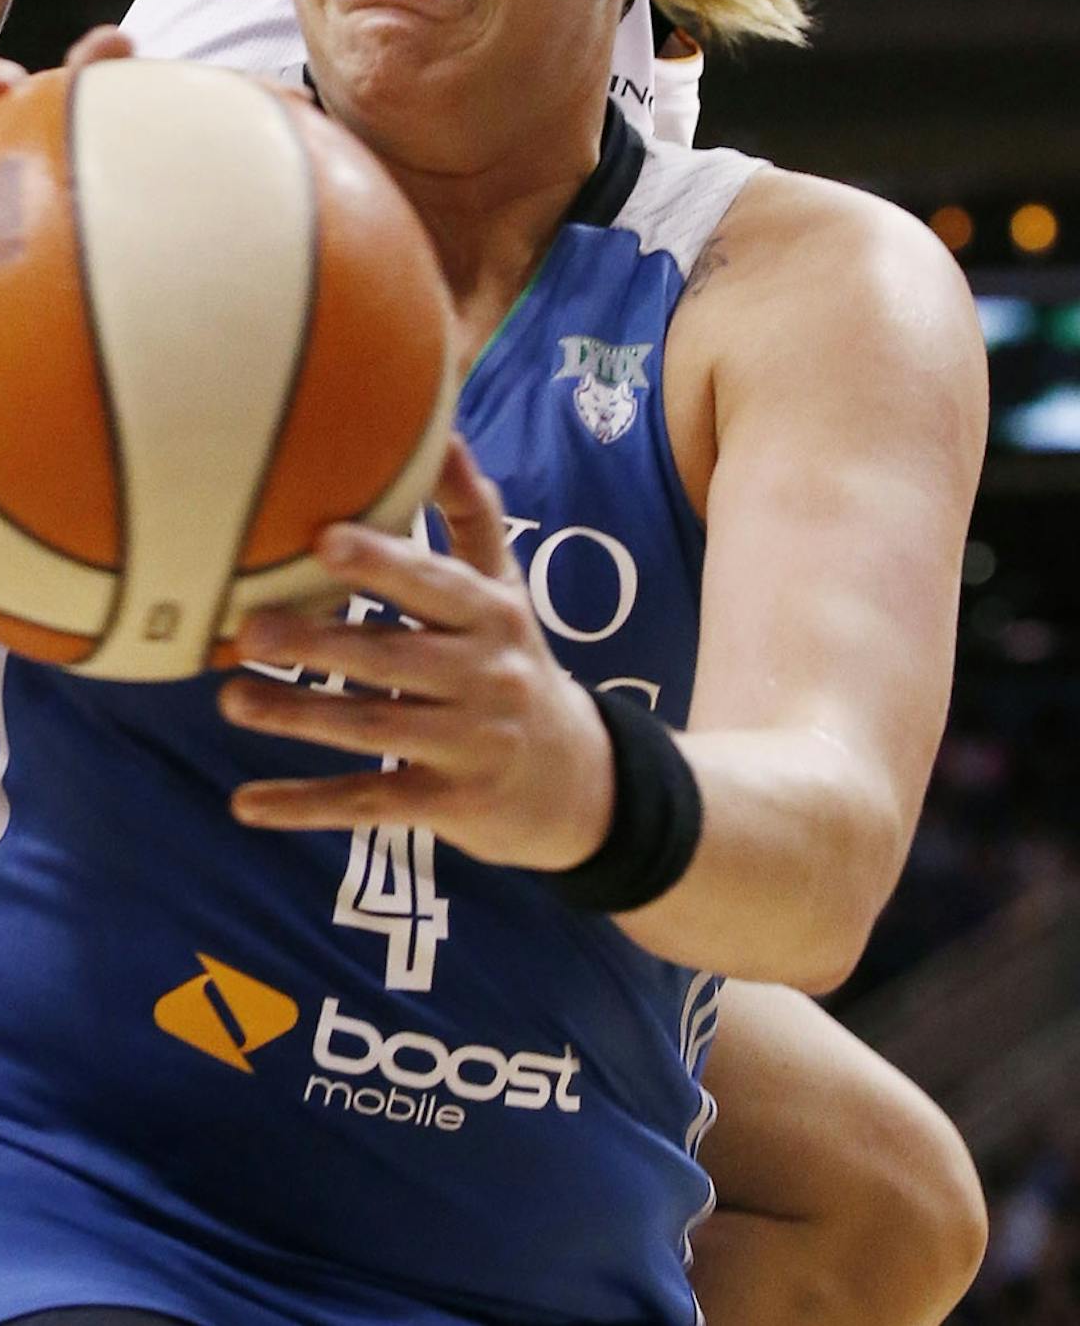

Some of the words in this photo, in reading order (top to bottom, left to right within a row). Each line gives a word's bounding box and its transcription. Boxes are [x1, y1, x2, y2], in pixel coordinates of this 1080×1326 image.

[332, 823, 450, 992] 4
[303, 1074, 466, 1132] mobile
[312, 996, 581, 1112] boost
